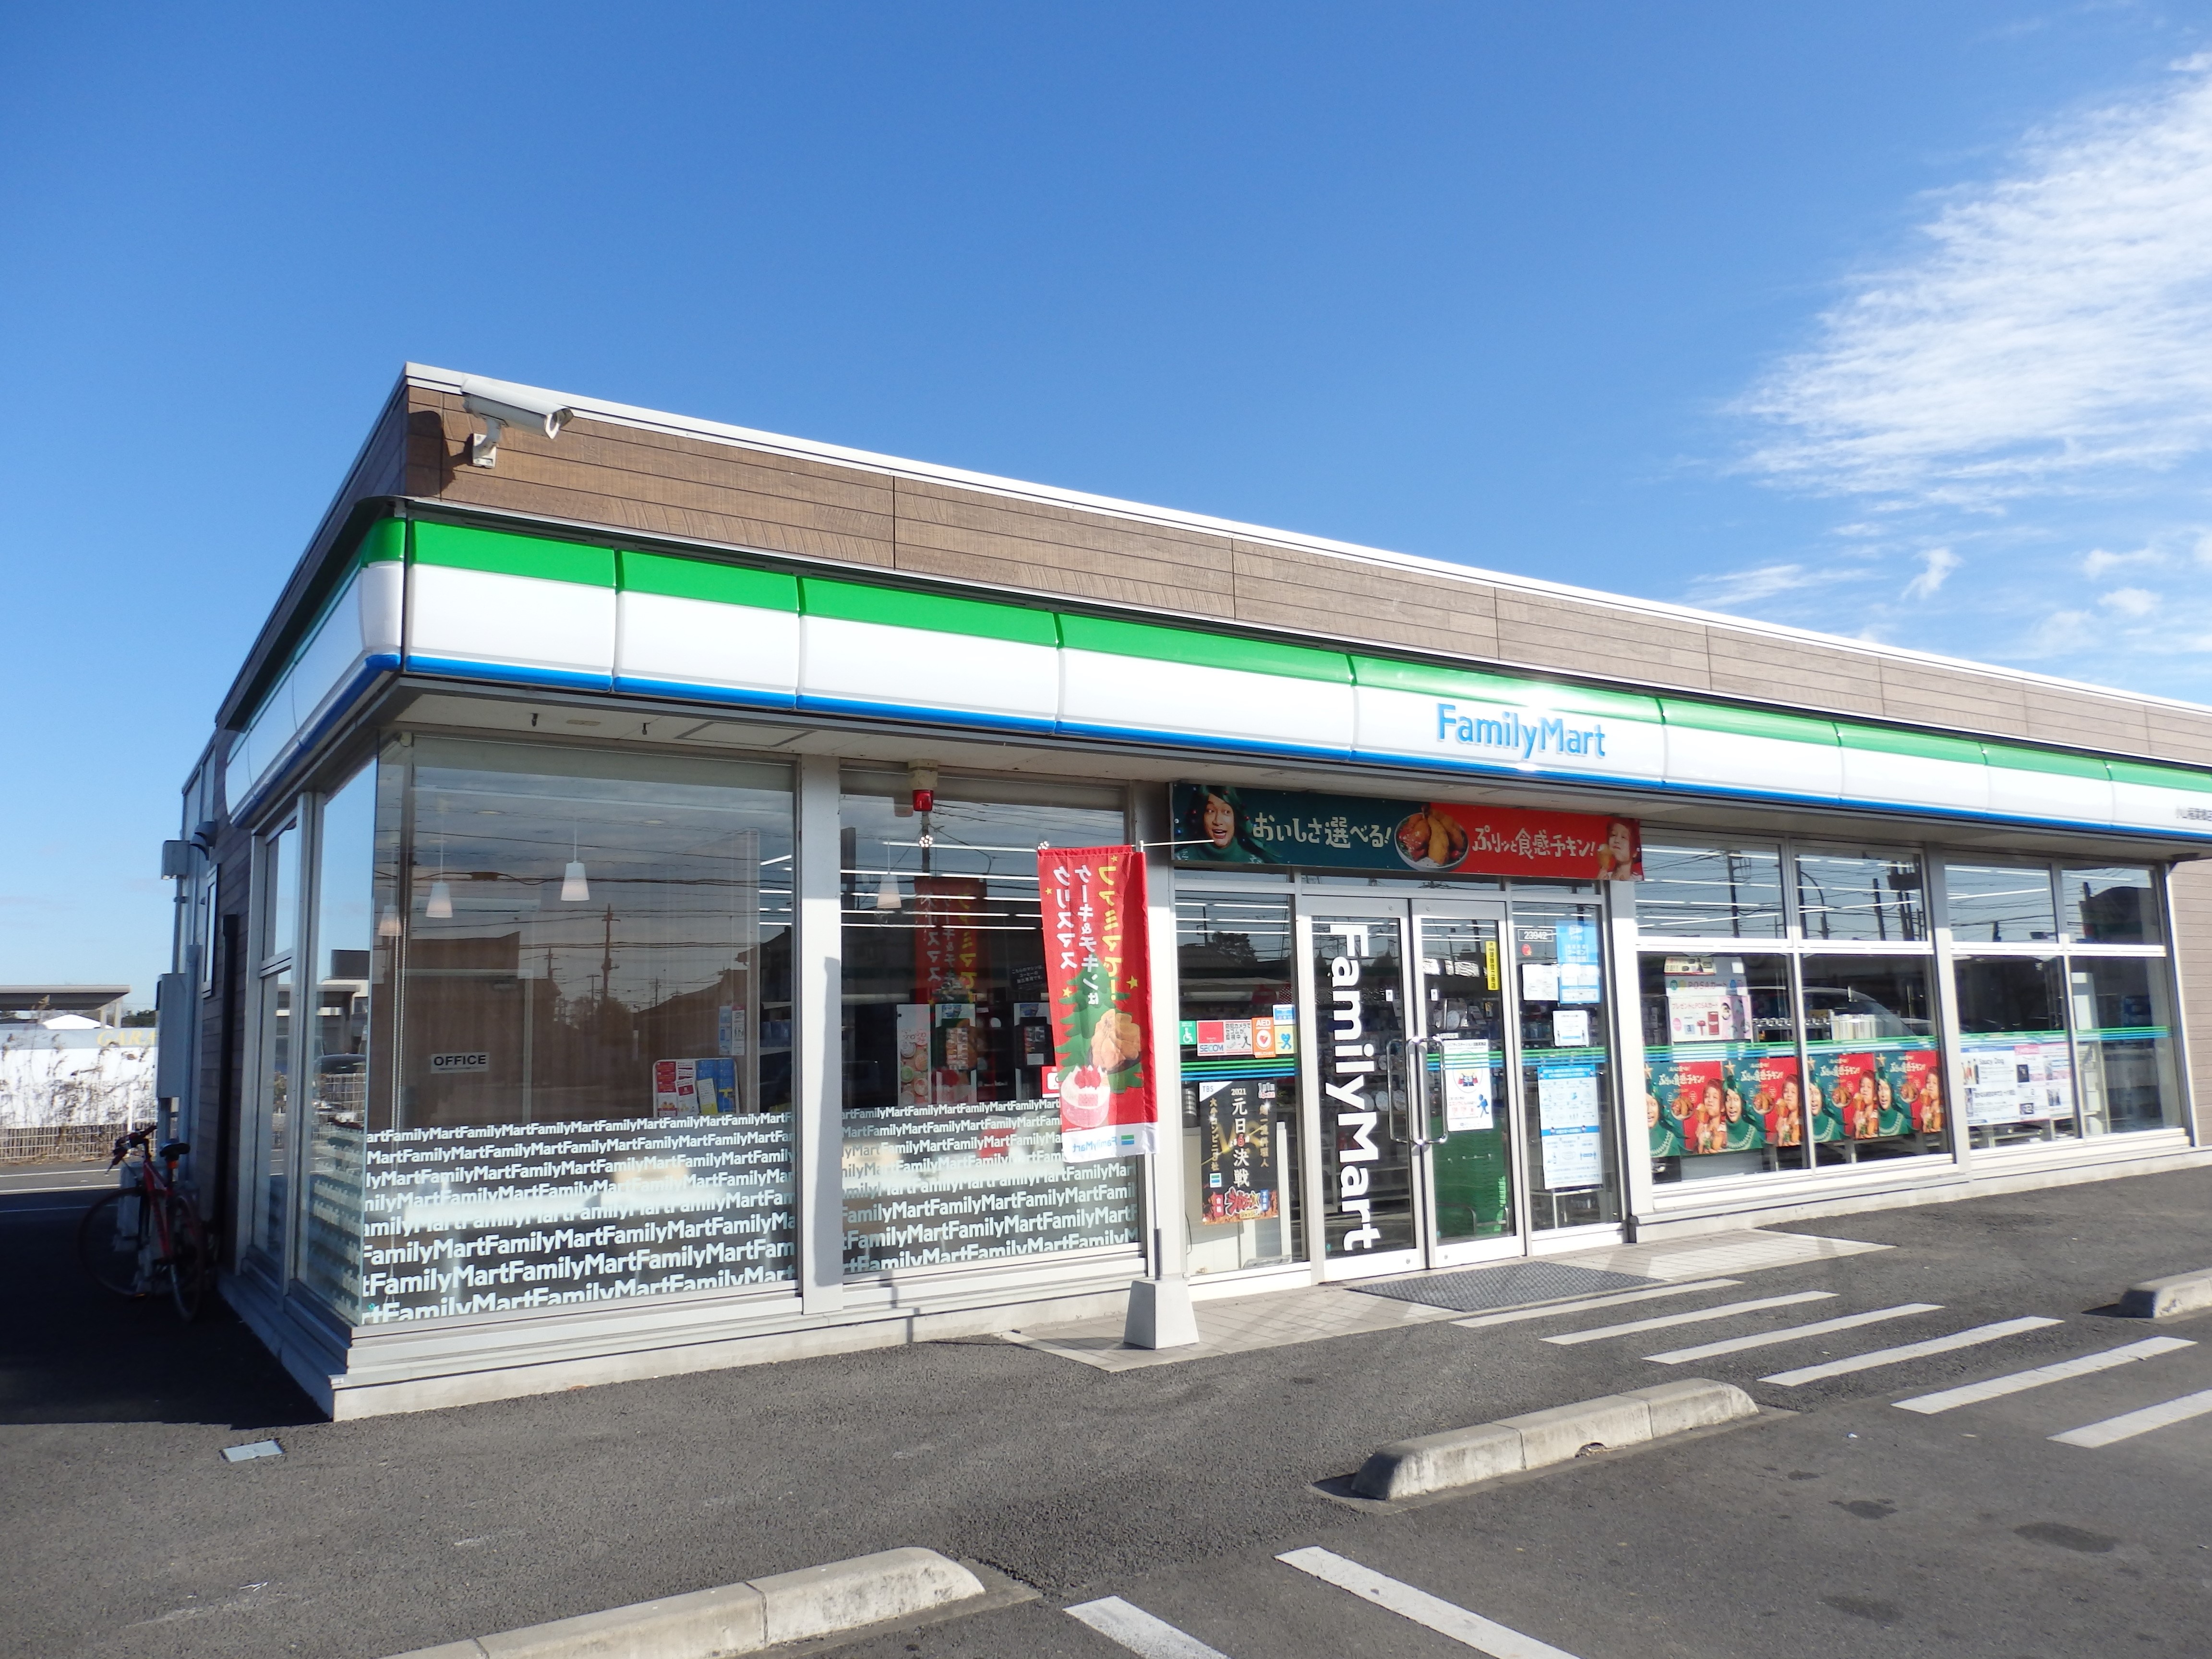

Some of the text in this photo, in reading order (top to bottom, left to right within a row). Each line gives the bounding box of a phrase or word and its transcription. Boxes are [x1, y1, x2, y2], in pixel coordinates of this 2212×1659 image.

[1437, 703, 1605, 761] FamilyMart
[1252, 812, 1392, 849] おいしさ選べる!
[434, 1055, 486, 1066] OFFICE
[1325, 924, 1381, 1251] FamilyMart
